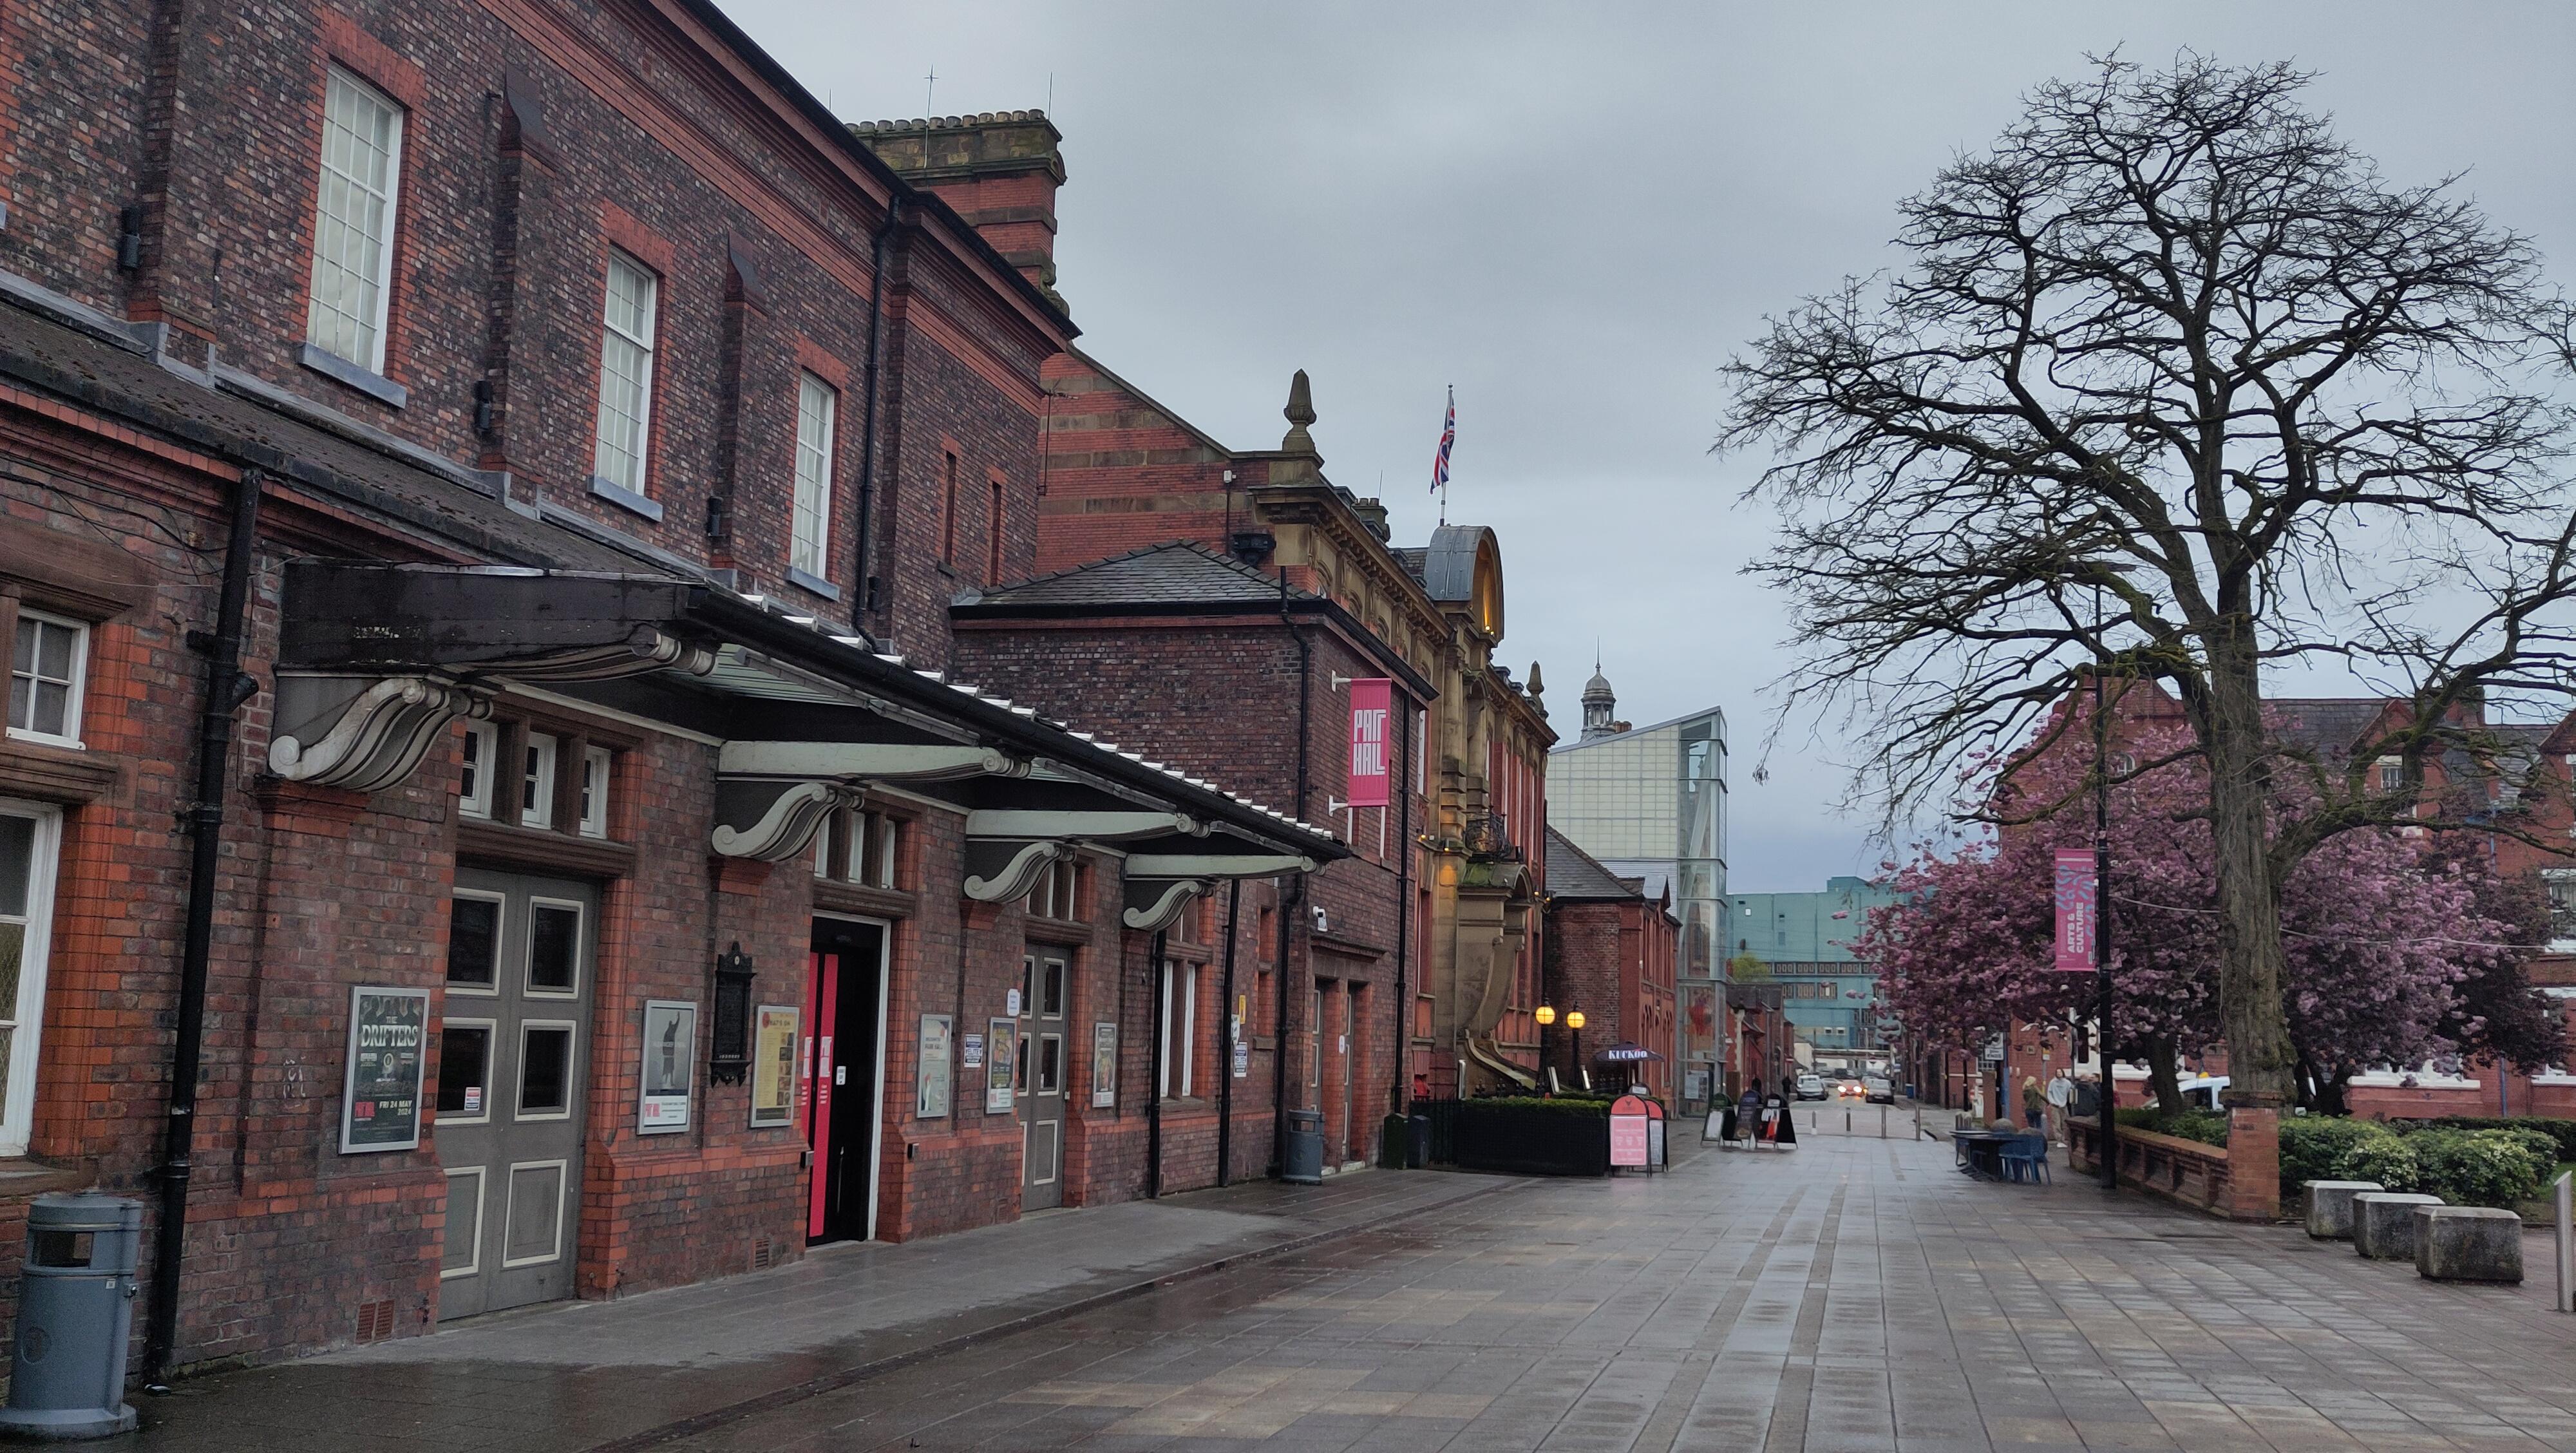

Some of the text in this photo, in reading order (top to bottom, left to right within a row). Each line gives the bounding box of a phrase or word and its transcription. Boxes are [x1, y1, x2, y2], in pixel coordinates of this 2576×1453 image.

[1353, 743, 1385, 775] HALL
[2076, 902, 2084, 953] CULTURE
[386, 1016, 397, 1024] THE
[361, 1025, 418, 1047] DRIFTERS
[1608, 1050, 1648, 1060] KUCKOO
